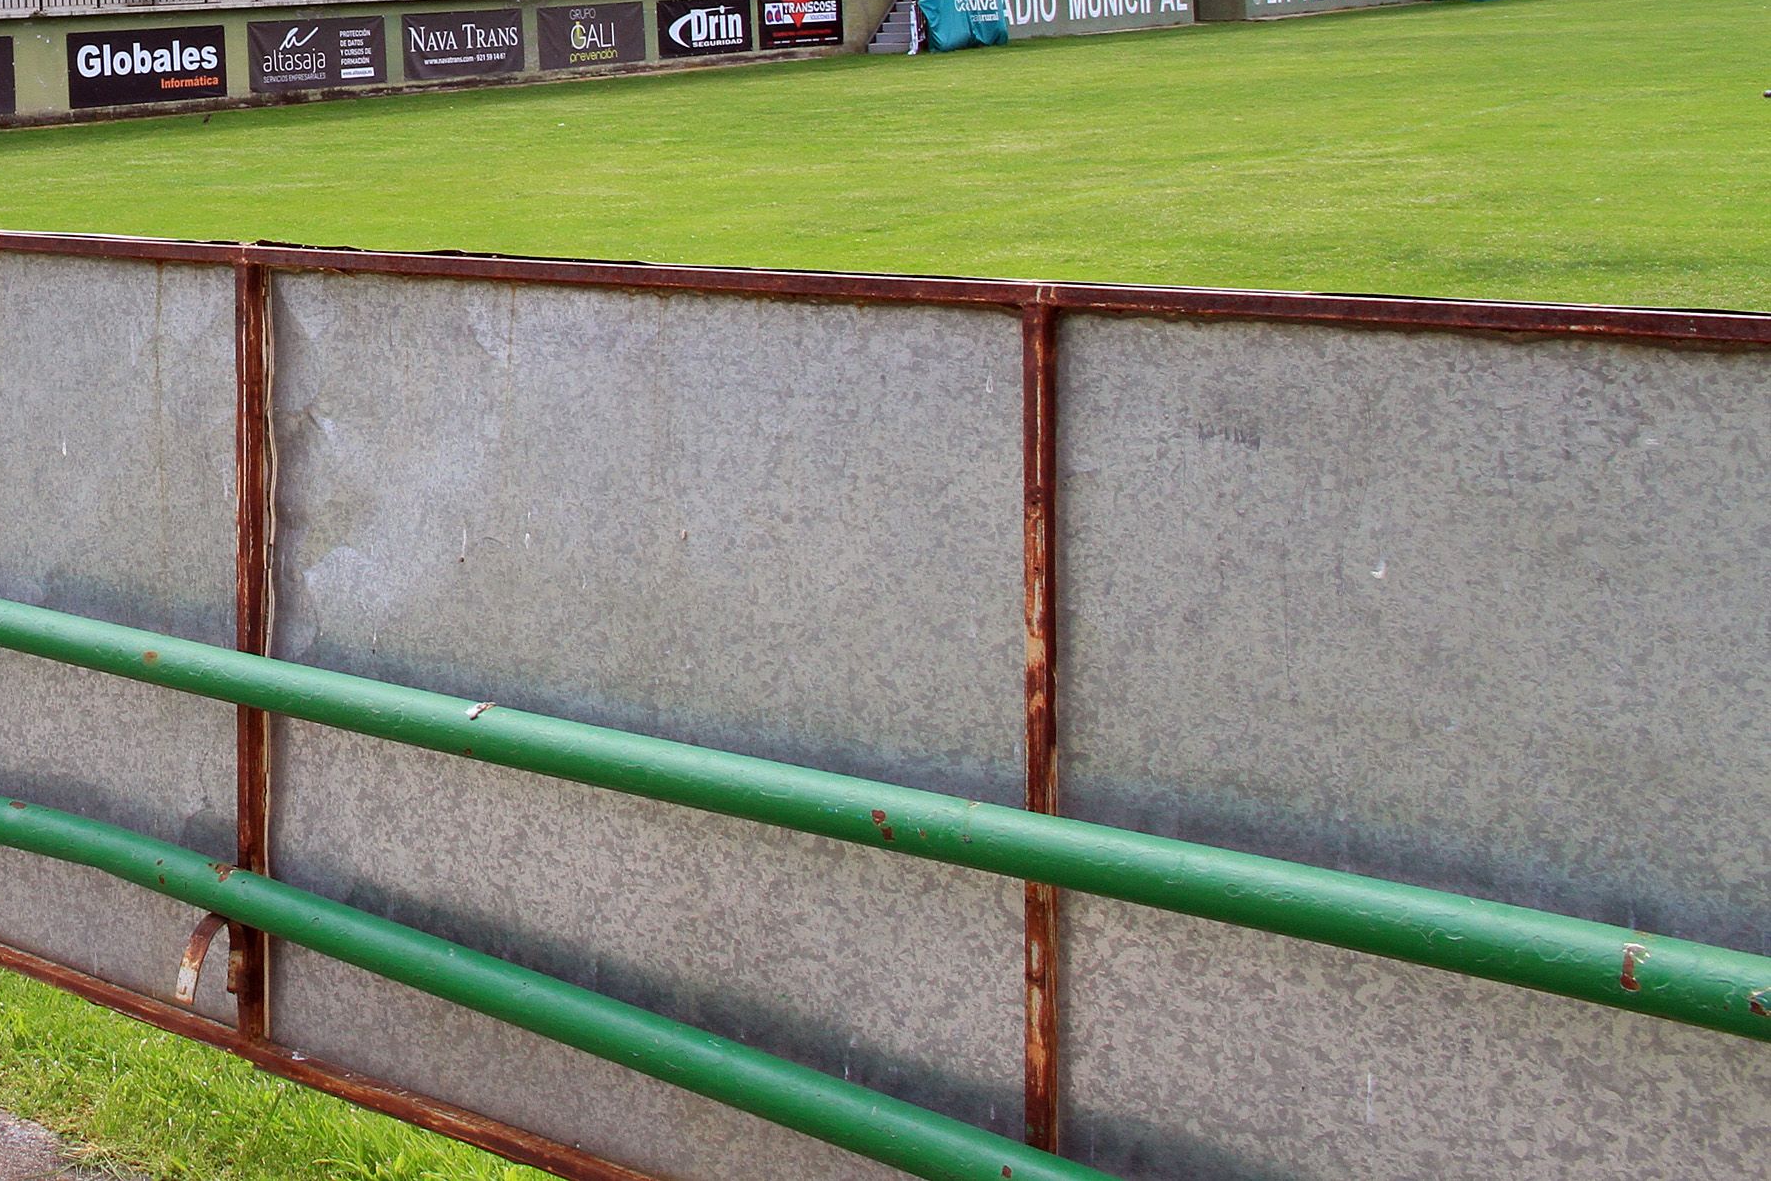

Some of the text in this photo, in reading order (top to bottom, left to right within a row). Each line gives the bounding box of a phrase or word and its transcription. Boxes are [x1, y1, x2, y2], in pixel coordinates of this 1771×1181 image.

[569, 7, 597, 21] GRUPO
[783, 0, 837, 14] TRANSCOSE
[690, 5, 743, 42] Drin
[570, 21, 616, 50] GALI
[692, 38, 744, 48] SEGURIDAD
[77, 39, 218, 78] Globales
[263, 47, 326, 74] altasaja
[569, 47, 619, 64] prevención
[161, 74, 219, 89] Informática
